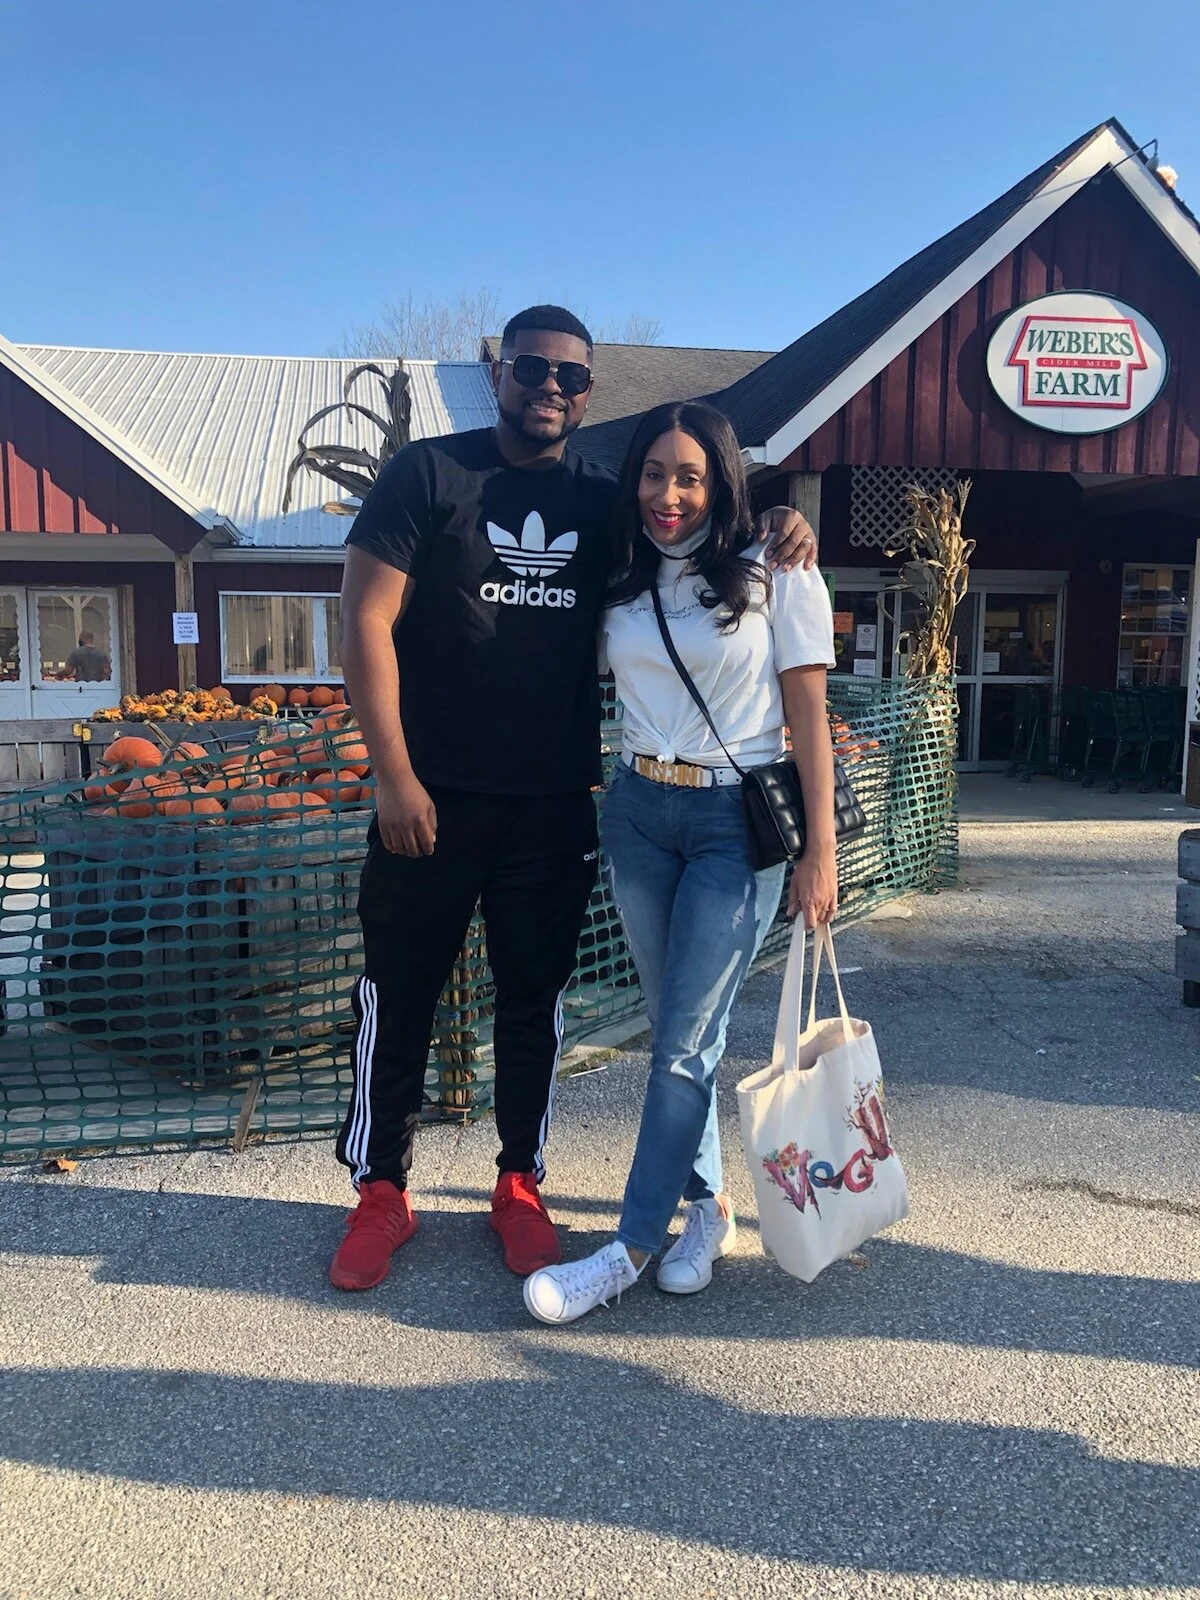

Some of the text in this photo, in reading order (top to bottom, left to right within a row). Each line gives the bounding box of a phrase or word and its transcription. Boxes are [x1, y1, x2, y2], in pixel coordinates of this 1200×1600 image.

[1027, 329, 1134, 357] WEBER'S
[1042, 358, 1116, 368] CIDER MILL
[1034, 371, 1121, 397] FARM
[479, 579, 577, 609] adidas
